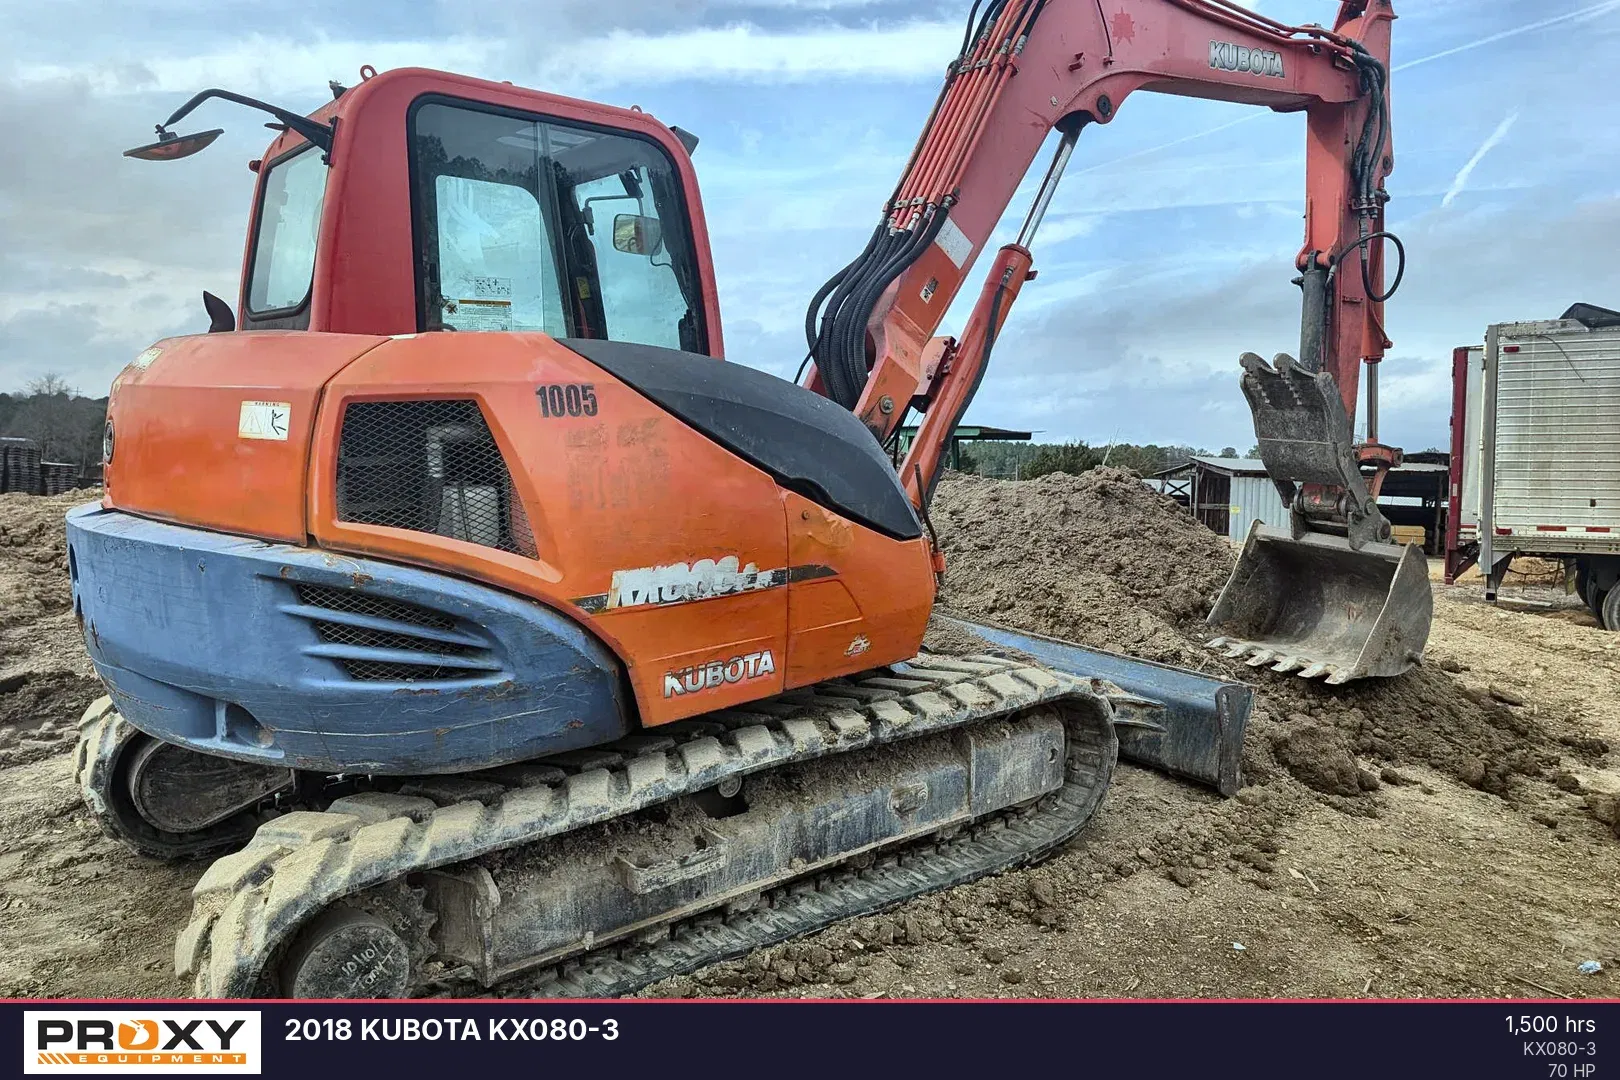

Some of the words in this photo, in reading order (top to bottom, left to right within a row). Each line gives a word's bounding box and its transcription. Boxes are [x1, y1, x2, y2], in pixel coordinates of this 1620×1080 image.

[1209, 40, 1285, 78] KUBOTA
[535, 384, 598, 418] 1005
[664, 650, 775, 698] KUBOTA
